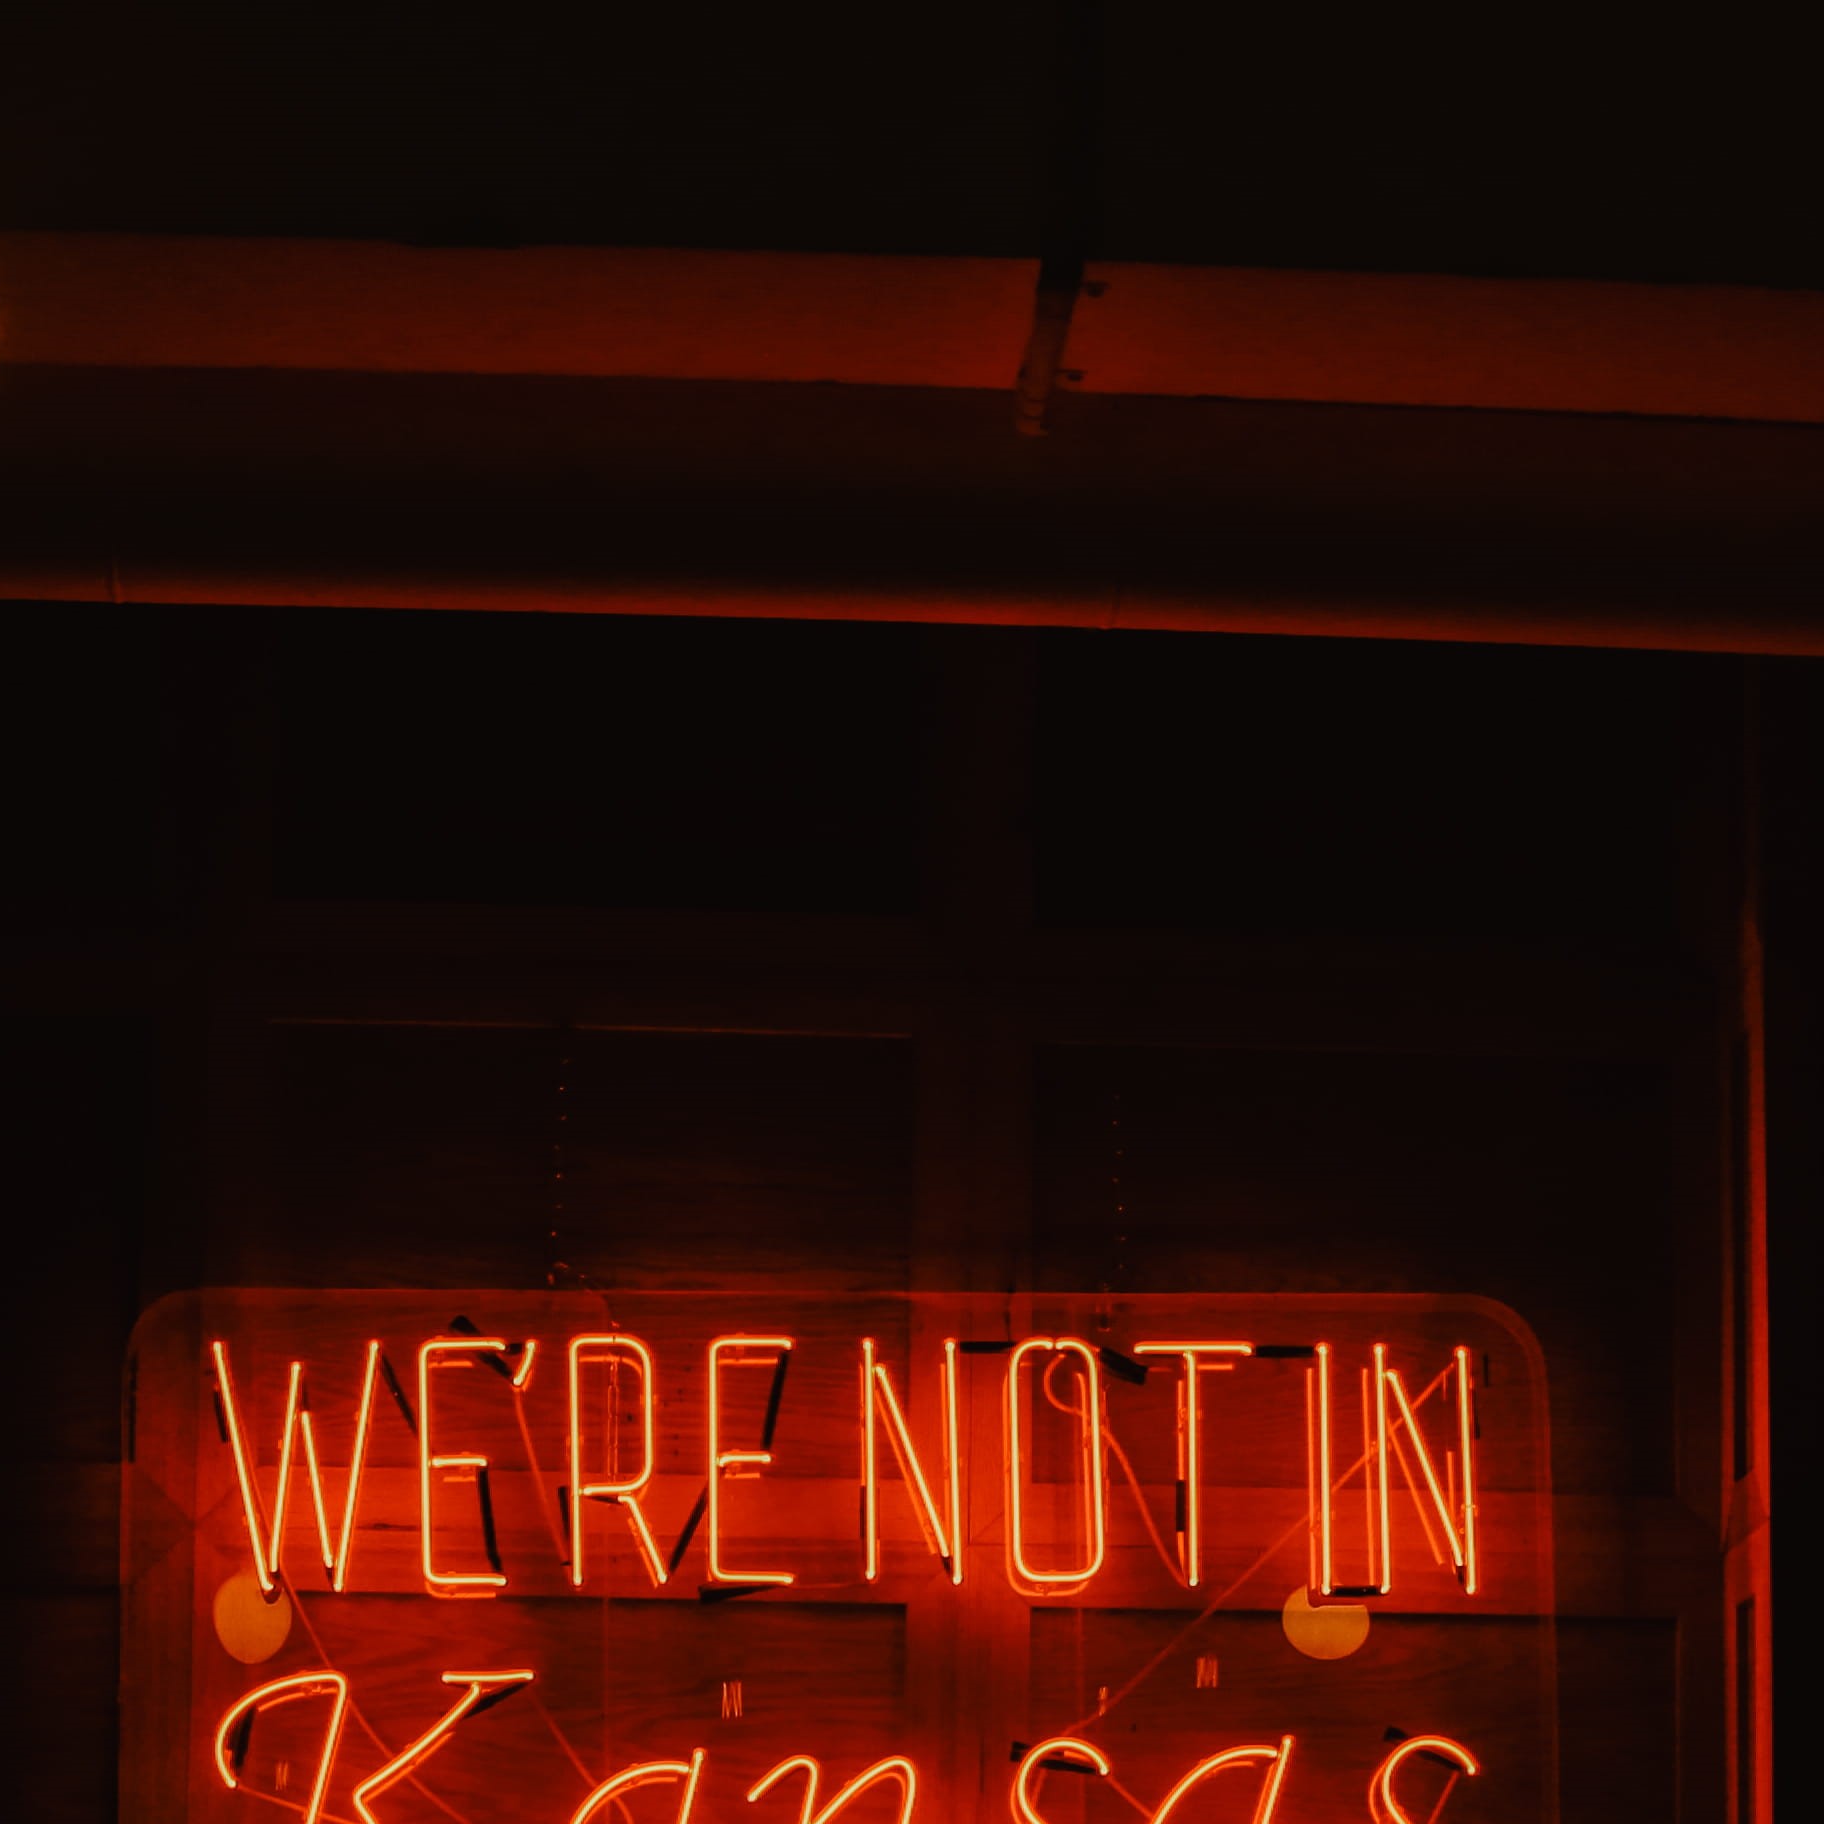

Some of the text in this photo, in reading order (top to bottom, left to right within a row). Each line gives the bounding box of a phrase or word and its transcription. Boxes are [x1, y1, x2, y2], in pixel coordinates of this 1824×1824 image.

[212, 1335, 1479, 1597] WE'RE NOT IN
